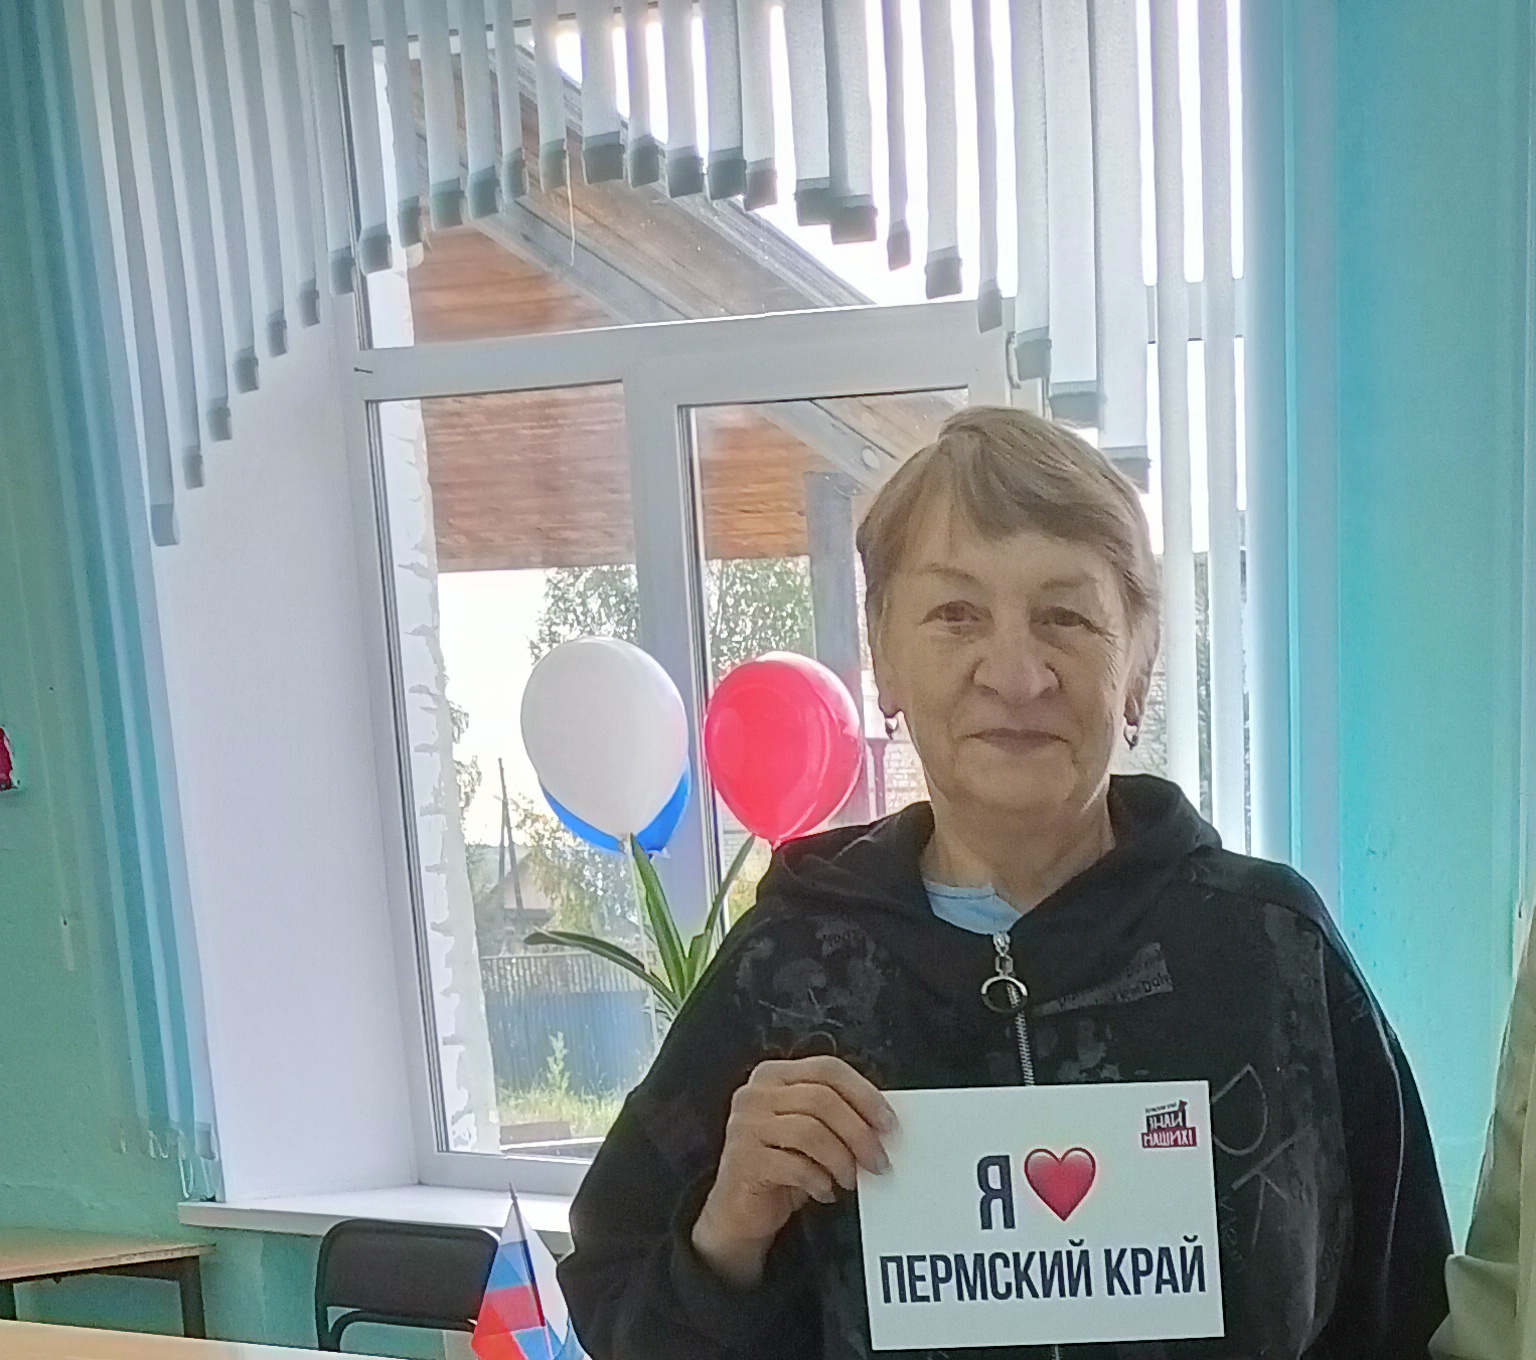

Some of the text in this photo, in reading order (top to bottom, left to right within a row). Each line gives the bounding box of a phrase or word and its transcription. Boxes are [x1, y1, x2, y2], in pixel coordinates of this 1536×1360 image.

[977, 1154, 1016, 1230] Я
[879, 1234, 1207, 1304] ПЕРМСКИЙ КРАЙ
